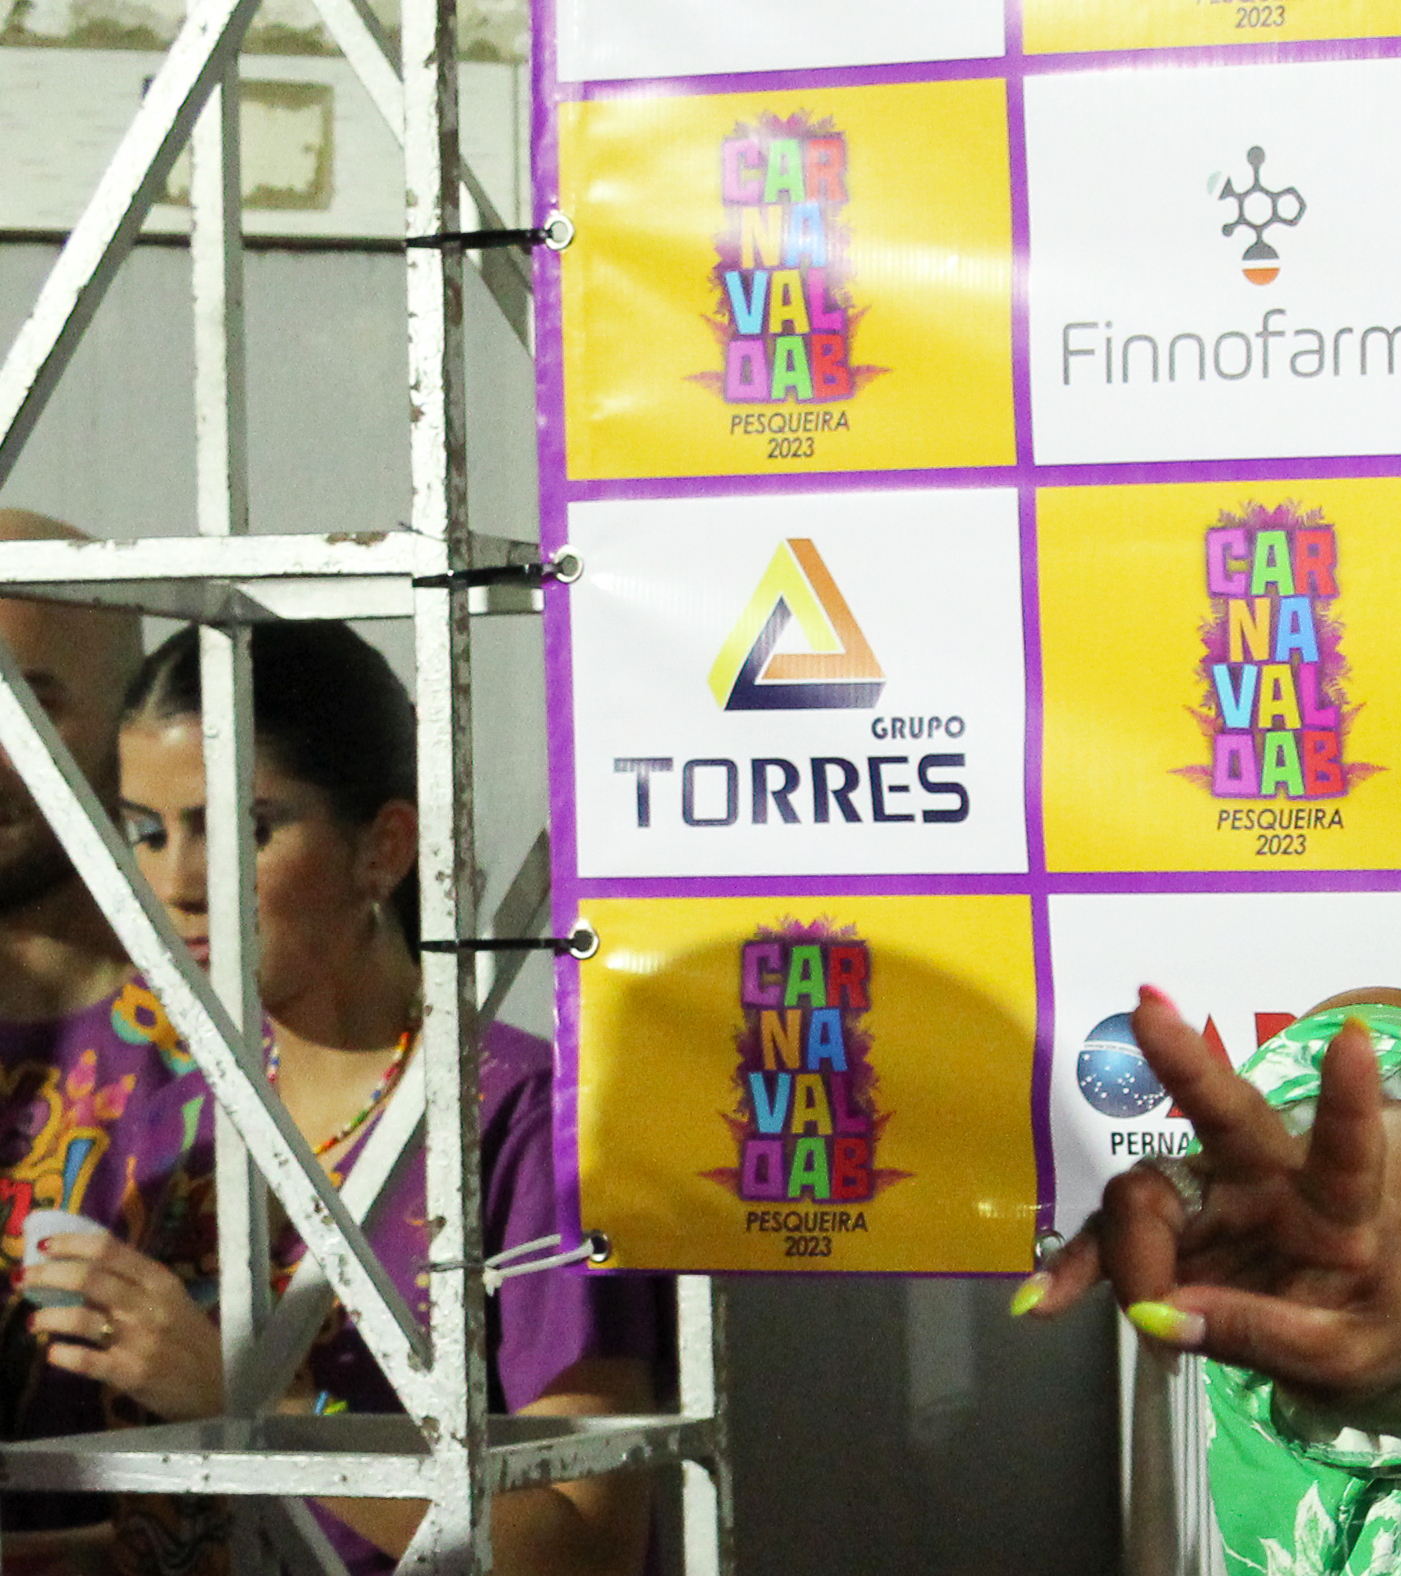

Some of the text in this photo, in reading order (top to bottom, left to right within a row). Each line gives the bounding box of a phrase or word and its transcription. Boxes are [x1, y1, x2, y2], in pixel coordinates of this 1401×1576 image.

[1234, 5, 1286, 28] 2023
[722, 138, 848, 202] CAR
[740, 203, 827, 268] NA
[724, 268, 846, 334] VAL
[725, 334, 852, 400] OAB
[730, 411, 850, 434] PESQUEIRA
[767, 437, 815, 459] 2023
[1207, 527, 1339, 597] CAR
[1228, 597, 1319, 662] NA
[871, 715, 966, 740] GRUPO
[1212, 662, 1340, 729] VAL
[613, 752, 970, 828] TORRES
[1212, 729, 1347, 797] OAB
[1216, 808, 1345, 831] PESQUEIRA
[1255, 834, 1307, 856] 2023
[741, 942, 871, 1008] CAR
[759, 1007, 848, 1072] NA
[748, 1071, 868, 1136] VAL
[741, 1136, 874, 1201] OAB
[1110, 1131, 1191, 1156] PERNA
[746, 1210, 868, 1234] PESQUEIRA
[784, 1235, 833, 1258] 2023
